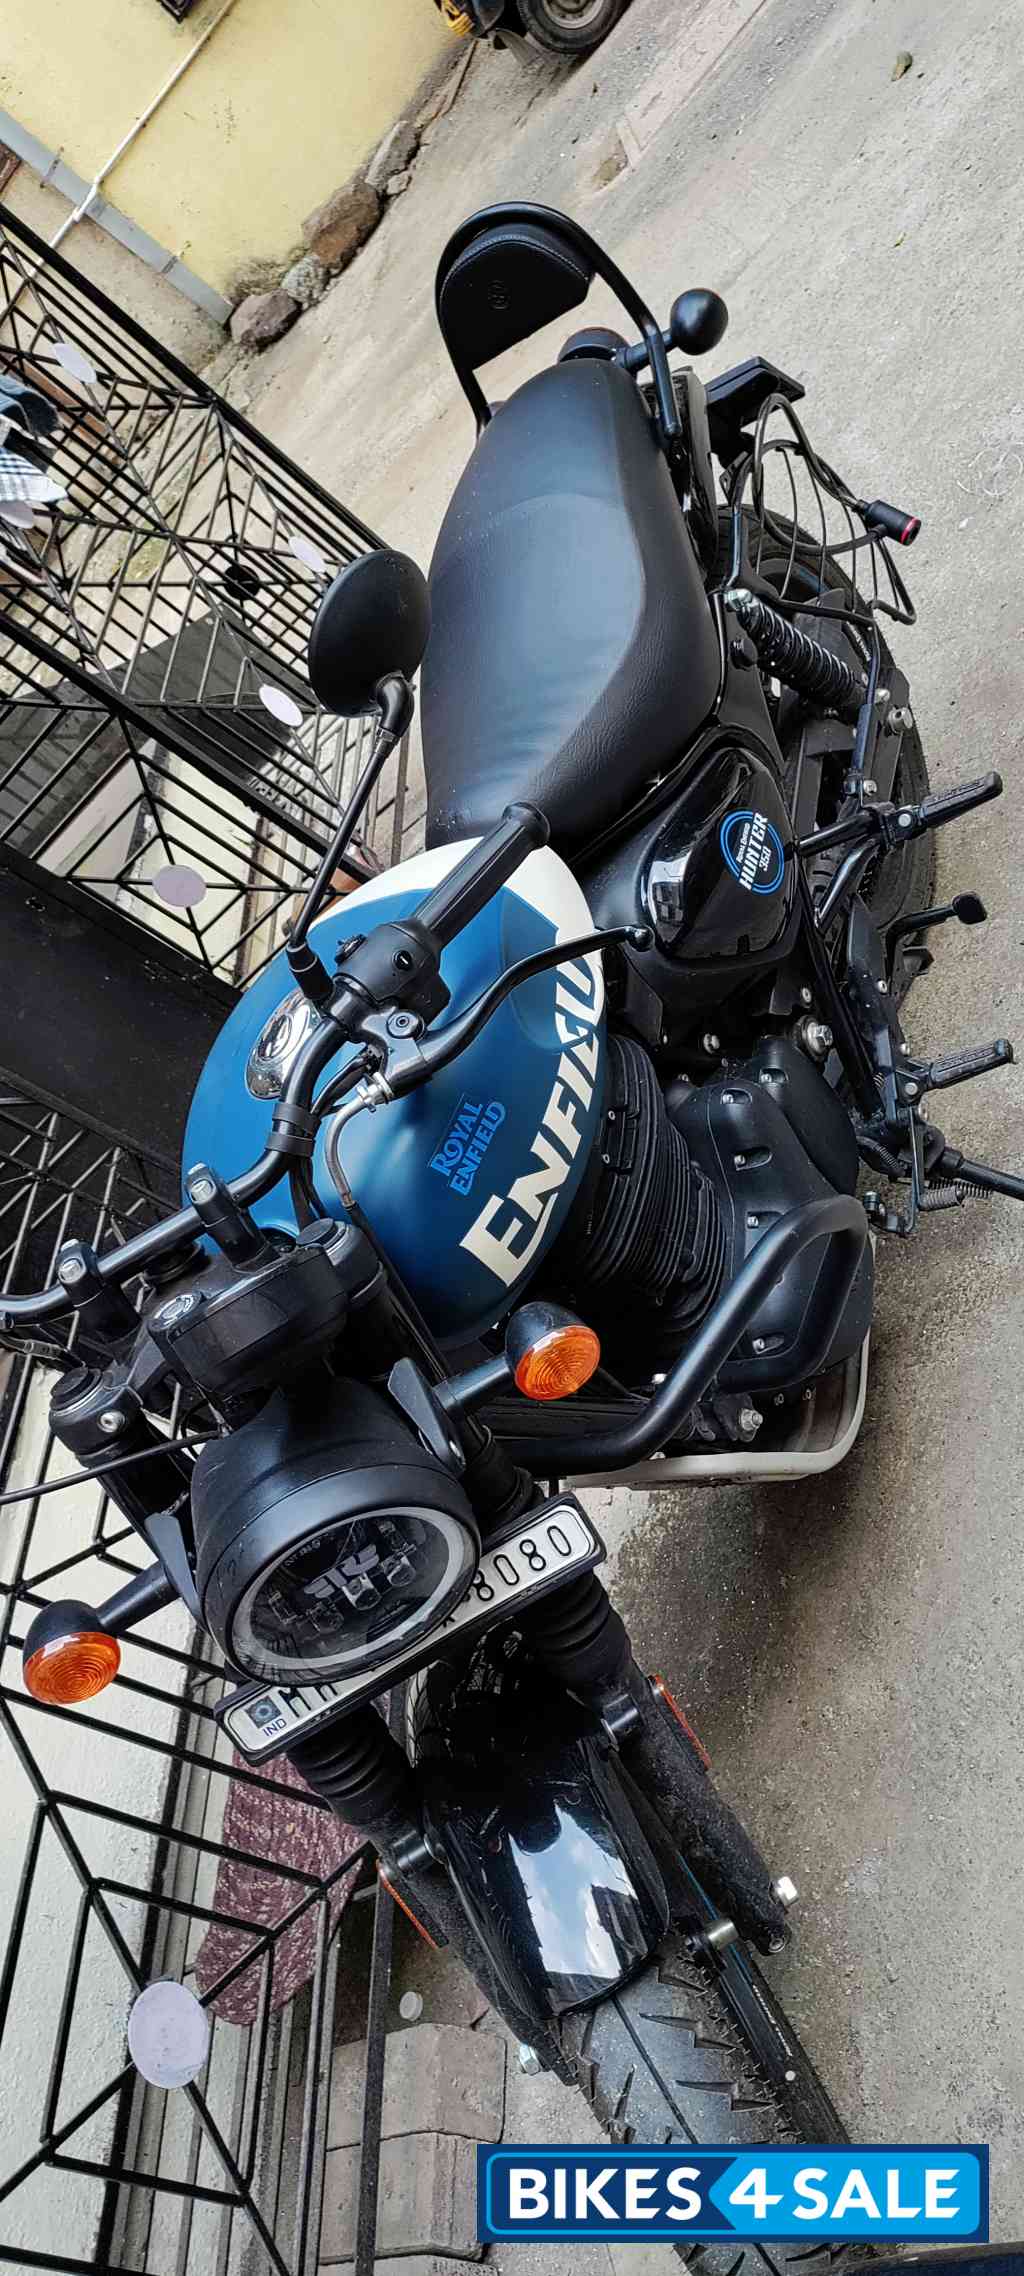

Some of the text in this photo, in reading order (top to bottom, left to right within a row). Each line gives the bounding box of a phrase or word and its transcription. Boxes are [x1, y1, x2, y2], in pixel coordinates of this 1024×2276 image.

[739, 812, 768, 890] HUNTER
[759, 845, 772, 872] 350
[430, 1102, 483, 1177] ROYAL
[449, 1101, 506, 1196] ENFIELD
[471, 1525, 572, 1601] 8080
[262, 1717, 288, 1737] IND
